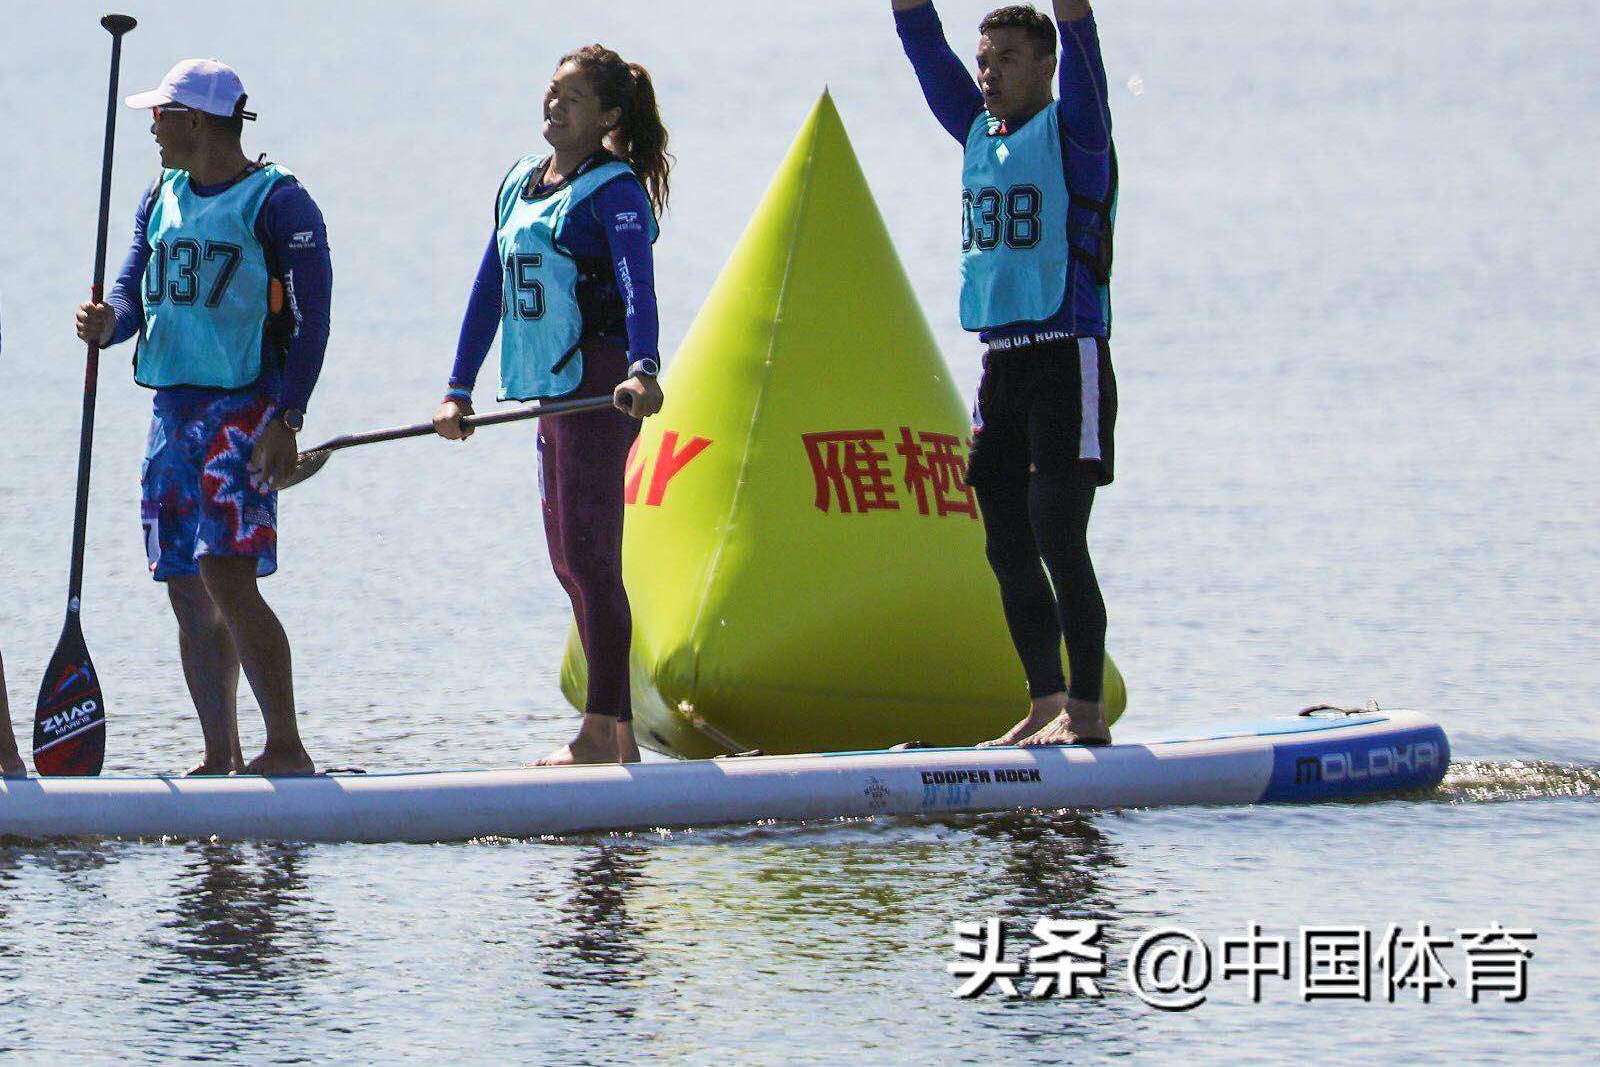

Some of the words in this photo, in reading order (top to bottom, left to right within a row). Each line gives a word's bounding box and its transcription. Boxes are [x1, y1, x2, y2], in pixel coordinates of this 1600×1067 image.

[962, 184, 1042, 253] 038
[145, 237, 243, 309] 037
[501, 252, 546, 321] 15
[801, 425, 978, 520] 雁栖
[41, 699, 98, 734] ZHAO
[921, 769, 992, 784] COOPER
[994, 768, 1042, 782] ROCK
